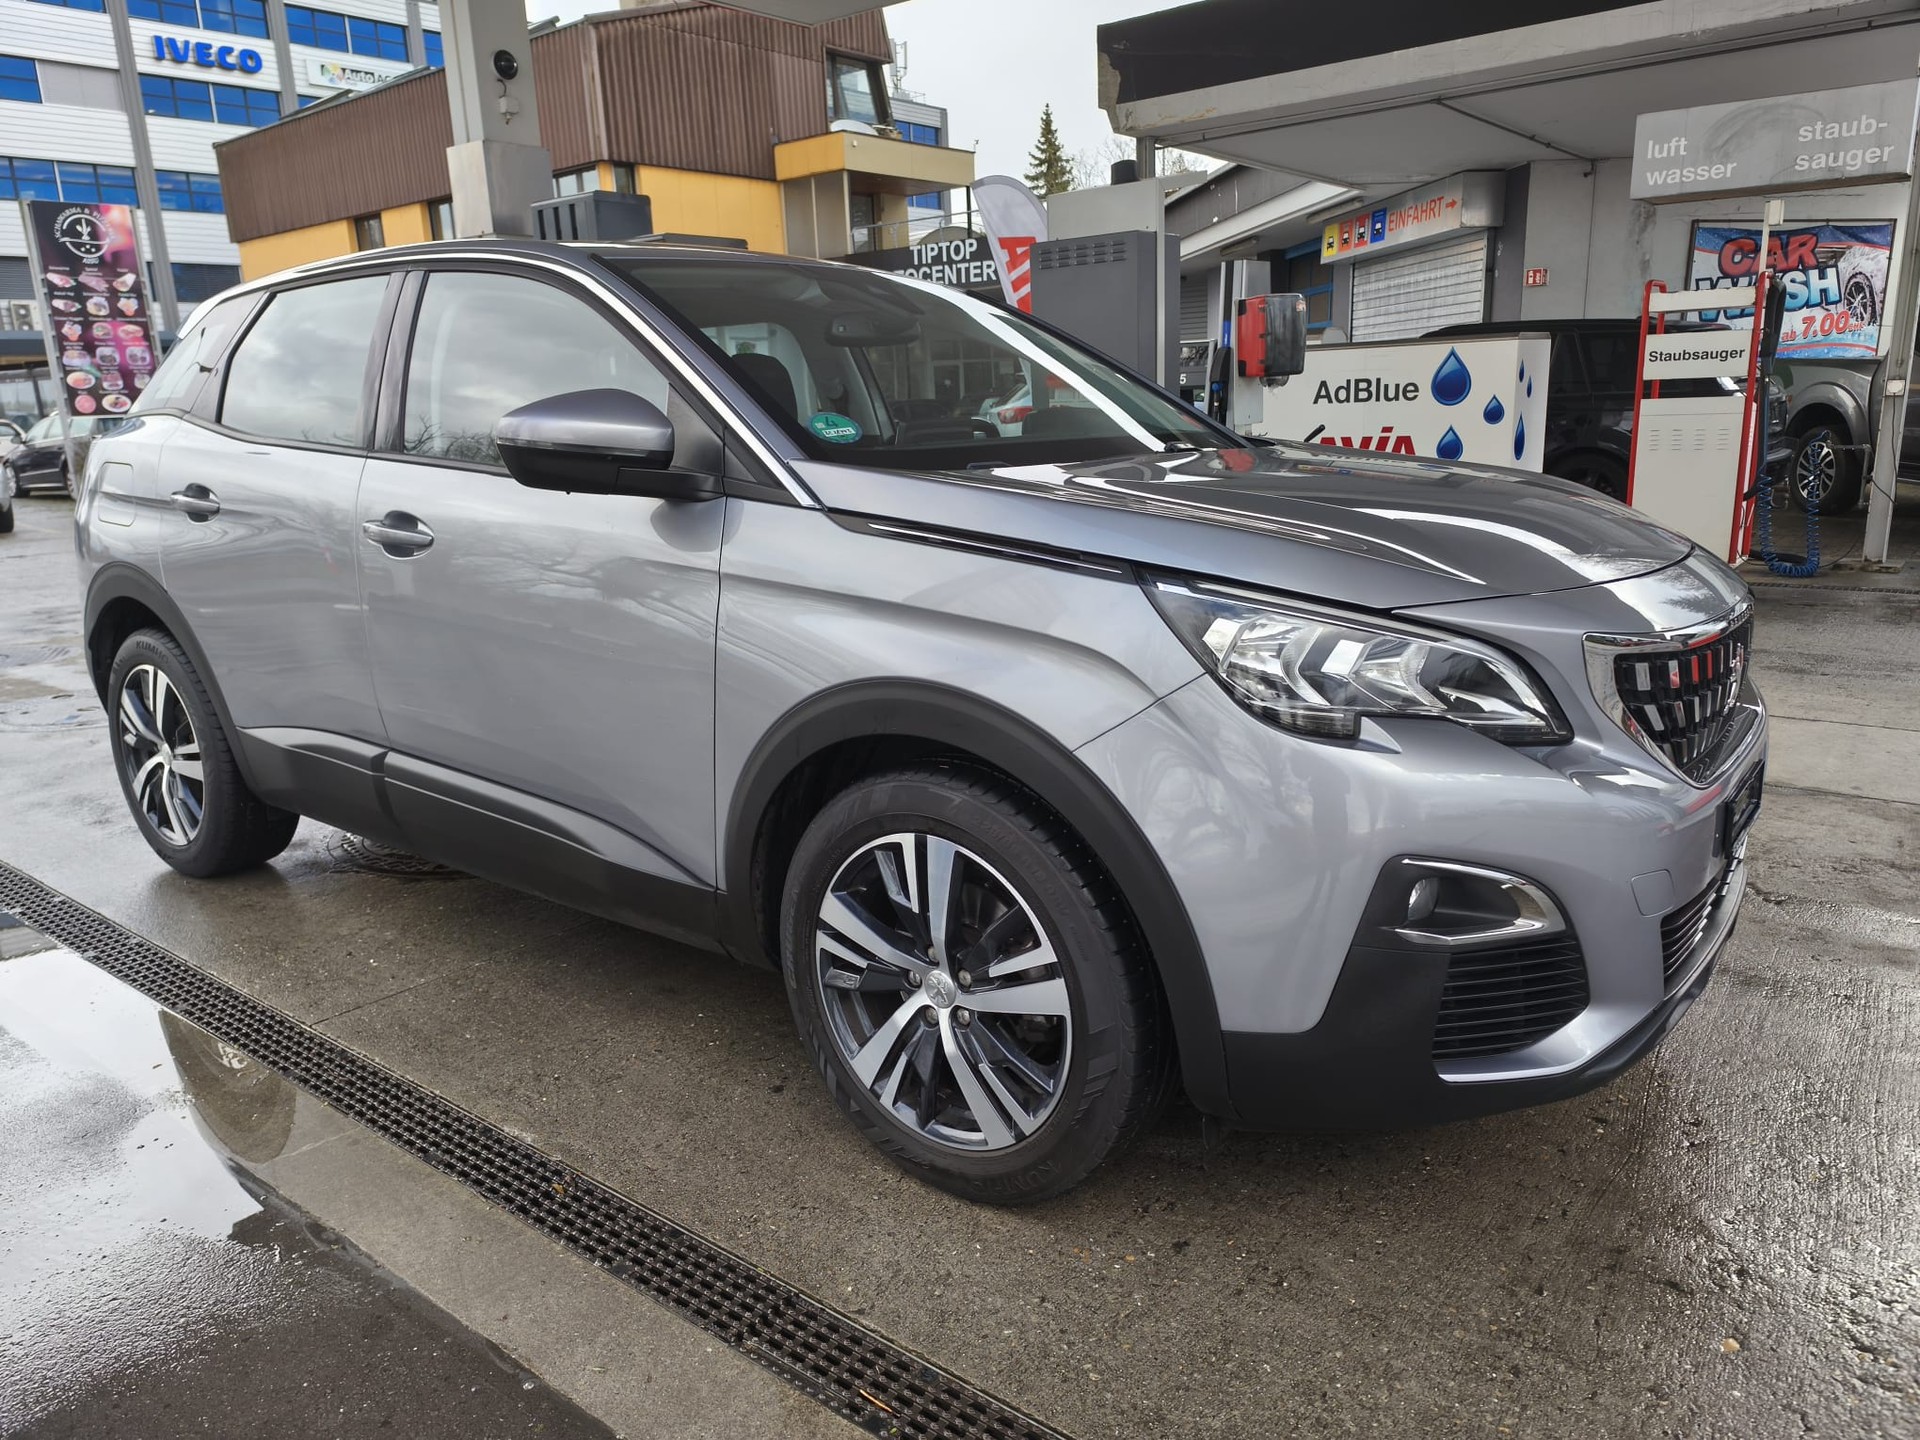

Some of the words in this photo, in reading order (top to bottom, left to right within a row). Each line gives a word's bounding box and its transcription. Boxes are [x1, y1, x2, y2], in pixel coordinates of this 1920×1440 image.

[153, 35, 263, 74] IVECO
[344, 69, 374, 84] Auto
[1798, 114, 1888, 142] staub-
[1647, 137, 1688, 159] luft
[1795, 144, 1895, 171] sauger
[1646, 160, 1737, 186] wasser
[1388, 196, 1445, 232] EINFAHRT
[910, 239, 977, 265] TIPTOP
[1718, 233, 1818, 277] CAR
[1696, 264, 1842, 323] WSH
[1781, 327, 1797, 343] ab
[1801, 310, 1850, 339] 7.00
[1649, 349, 1745, 362] Staubsauger
[1313, 377, 1419, 404] AdBlue
